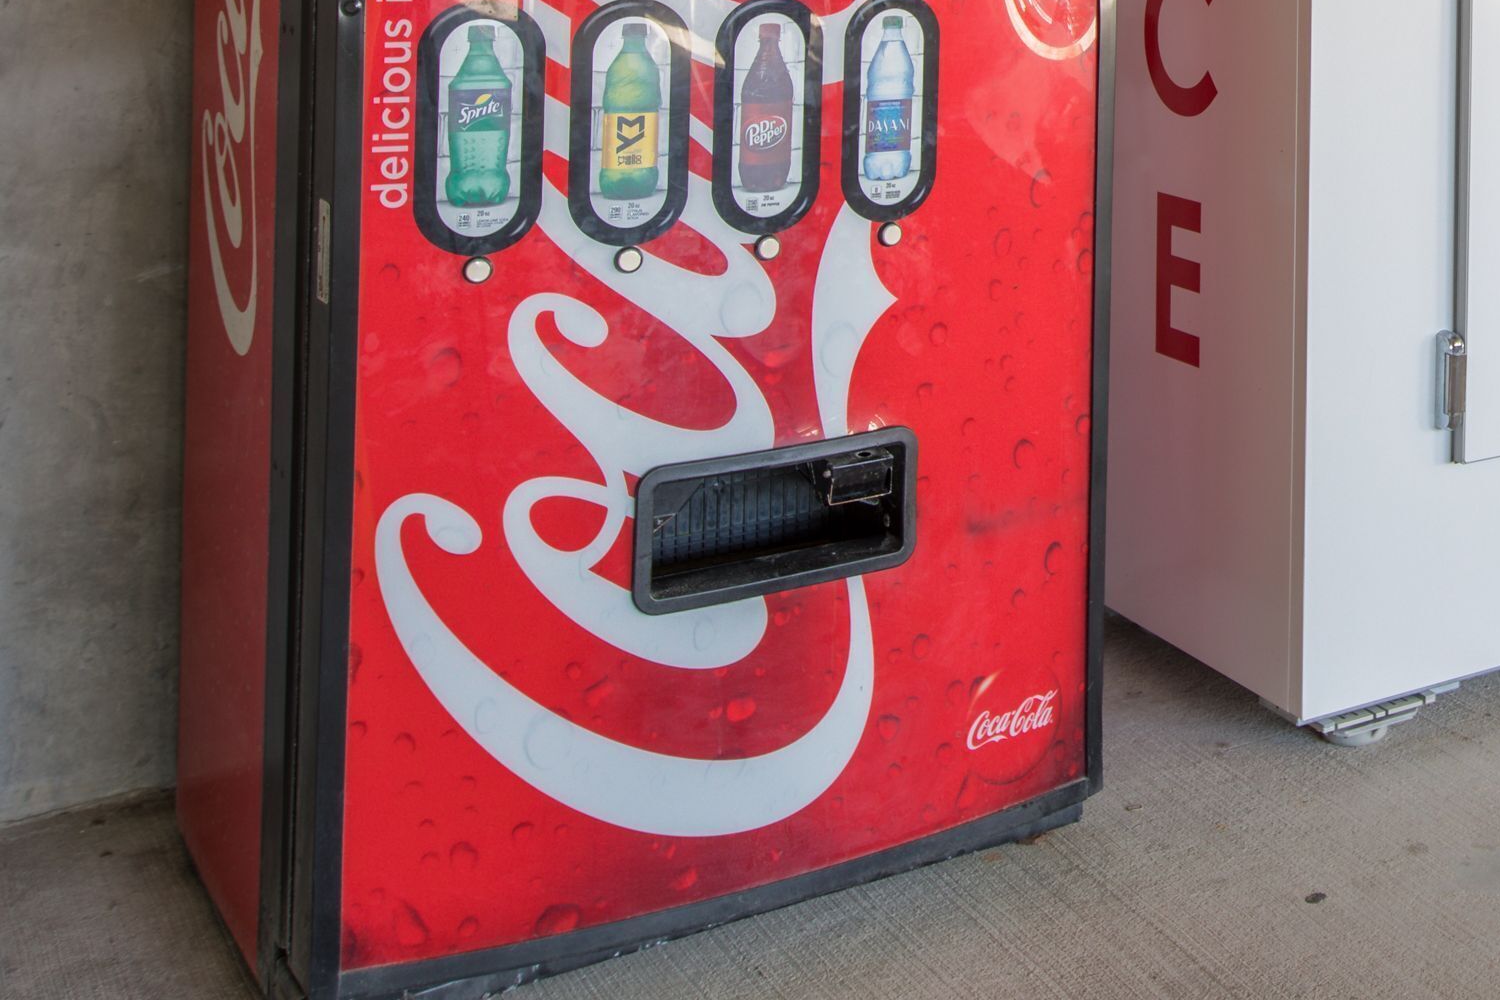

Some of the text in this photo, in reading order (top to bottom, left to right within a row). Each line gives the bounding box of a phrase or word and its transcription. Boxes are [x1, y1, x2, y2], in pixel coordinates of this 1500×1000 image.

[370, 18, 412, 210] delicious
[458, 99, 500, 124] Sprite
[746, 123, 785, 146] Pepper
[760, 120, 776, 133] Dr
[868, 118, 909, 133] DASANI
[966, 689, 1058, 751] Coca-Cola
